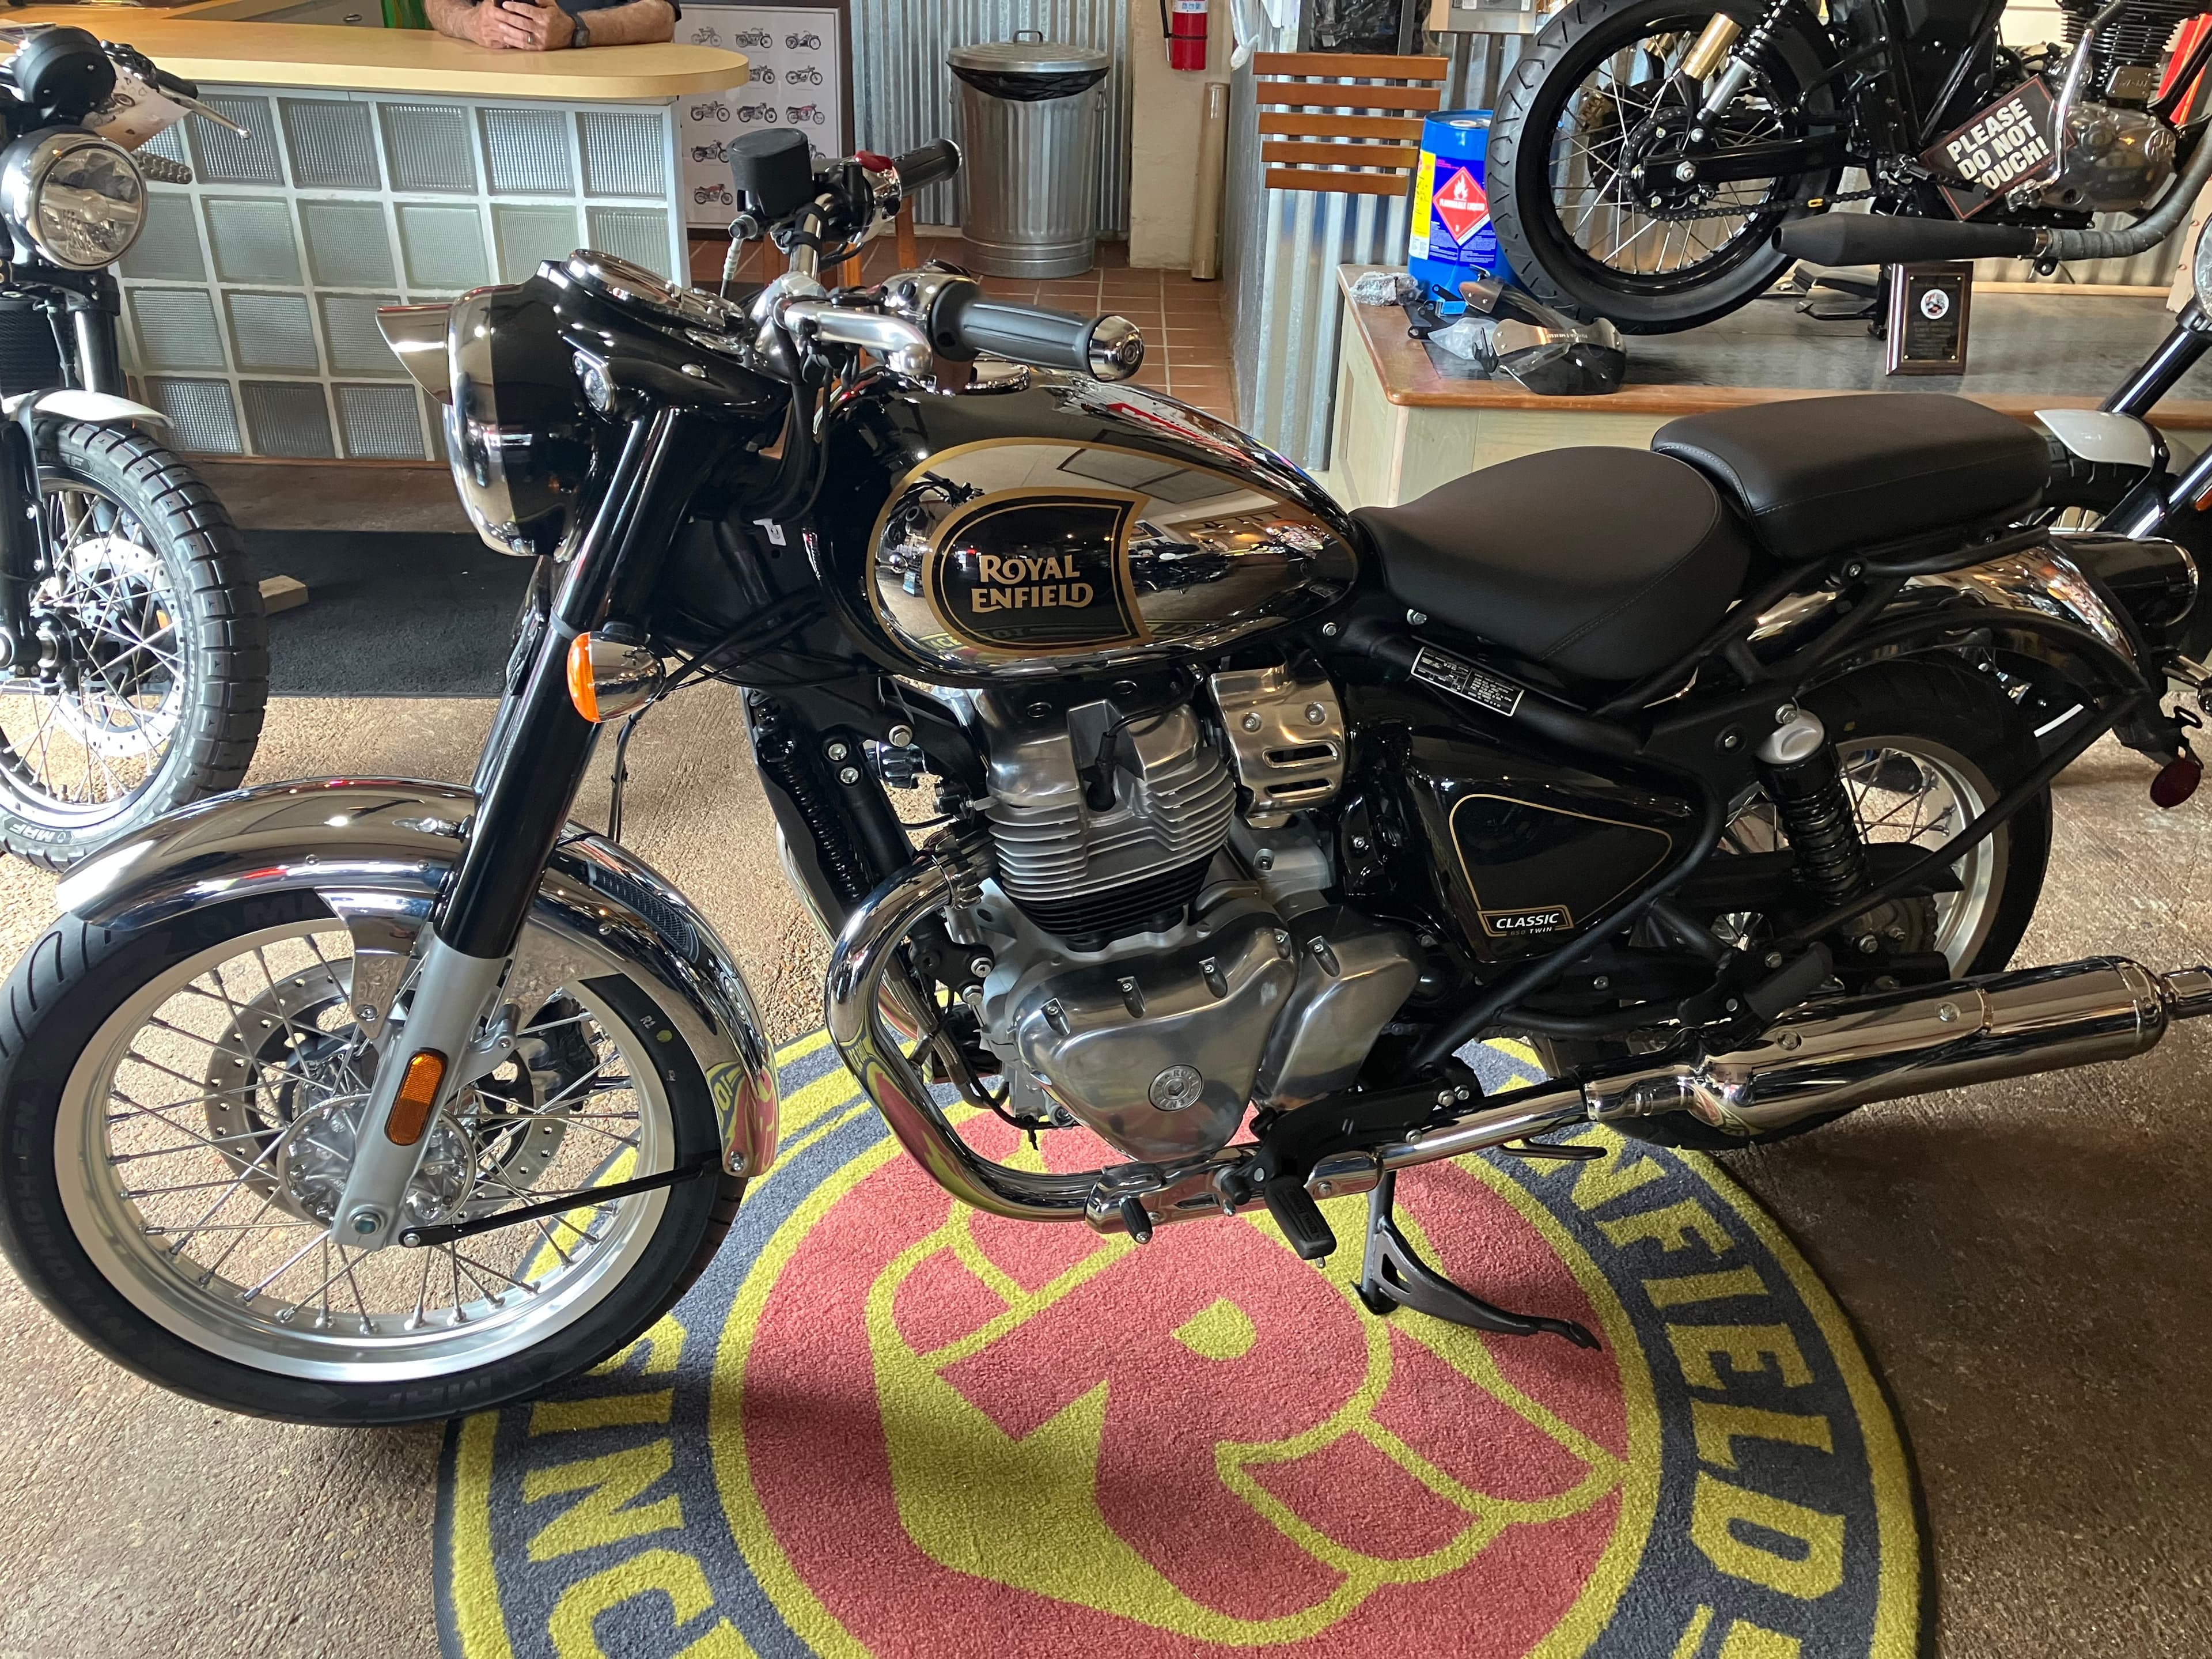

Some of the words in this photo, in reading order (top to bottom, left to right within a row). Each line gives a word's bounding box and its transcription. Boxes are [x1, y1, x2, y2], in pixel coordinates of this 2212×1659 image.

[1946, 97, 2028, 162] PLEASE
[1957, 149, 1991, 180] DO
[1991, 115, 2036, 158] NOT
[1974, 136, 2050, 190] OUCH!
[979, 555, 1080, 585] ROYAL
[971, 583, 1093, 613] ENFIELD
[9, 824, 56, 843] MRF
[1496, 913, 1559, 929] CLASSIC
[1529, 926, 1552, 934] TWIN
[1495, 1074, 1845, 1600] NFIELD
